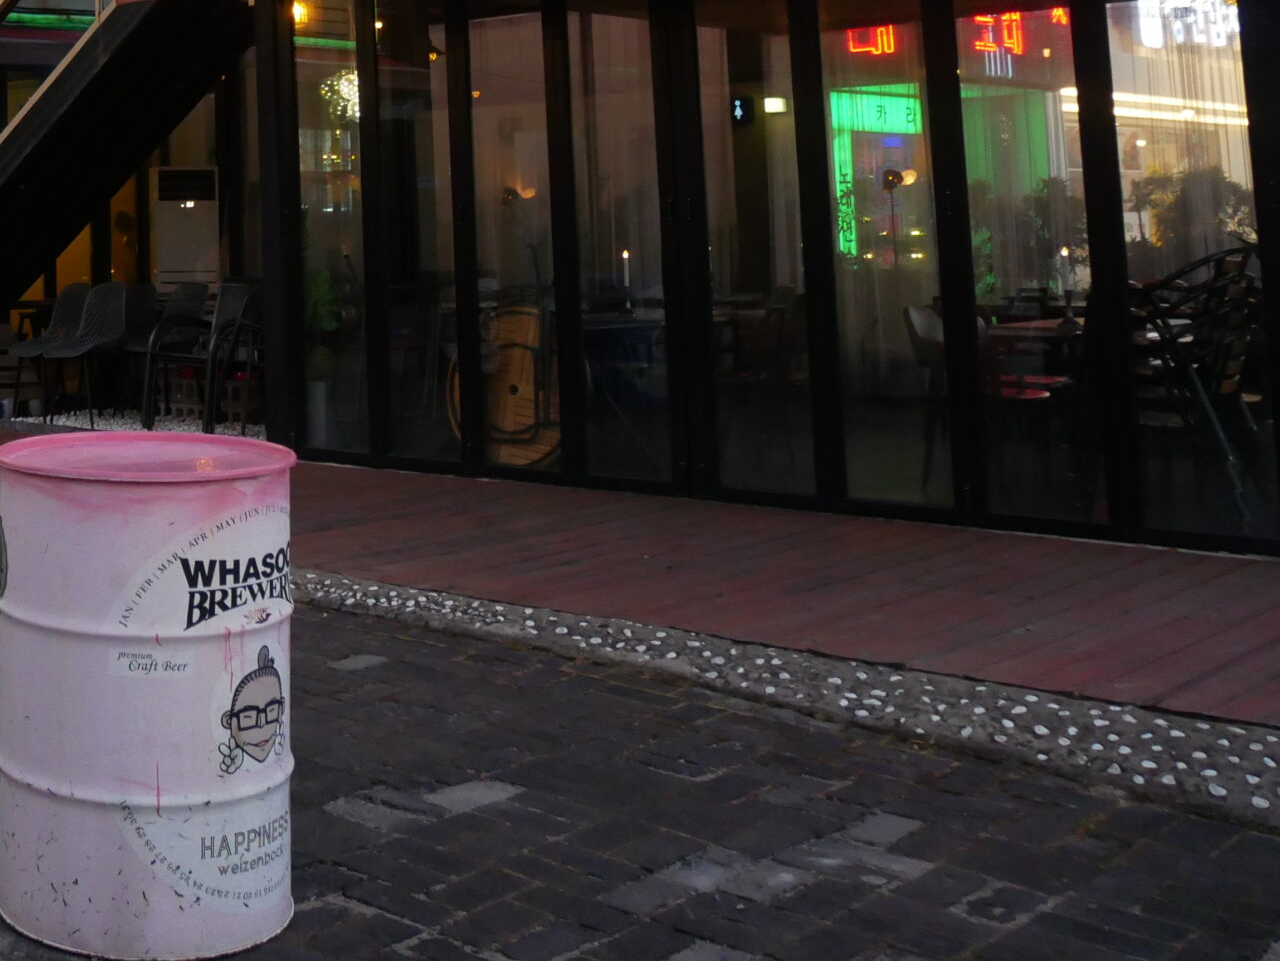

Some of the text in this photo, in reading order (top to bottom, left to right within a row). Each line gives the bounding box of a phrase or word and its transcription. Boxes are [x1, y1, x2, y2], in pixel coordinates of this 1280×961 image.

[118, 605, 133, 628] JAN
[135, 578, 154, 600] FEB
[157, 552, 181, 575] MAR
[188, 532, 208, 551] APR
[215, 515, 237, 533] MAY
[243, 508, 260, 523] JUN
[117, 651, 153, 661] premium
[128, 659, 189, 675] Craft Beer
[200, 809, 289, 860] HAPPINESS
[217, 843, 284, 877] weizenbock
